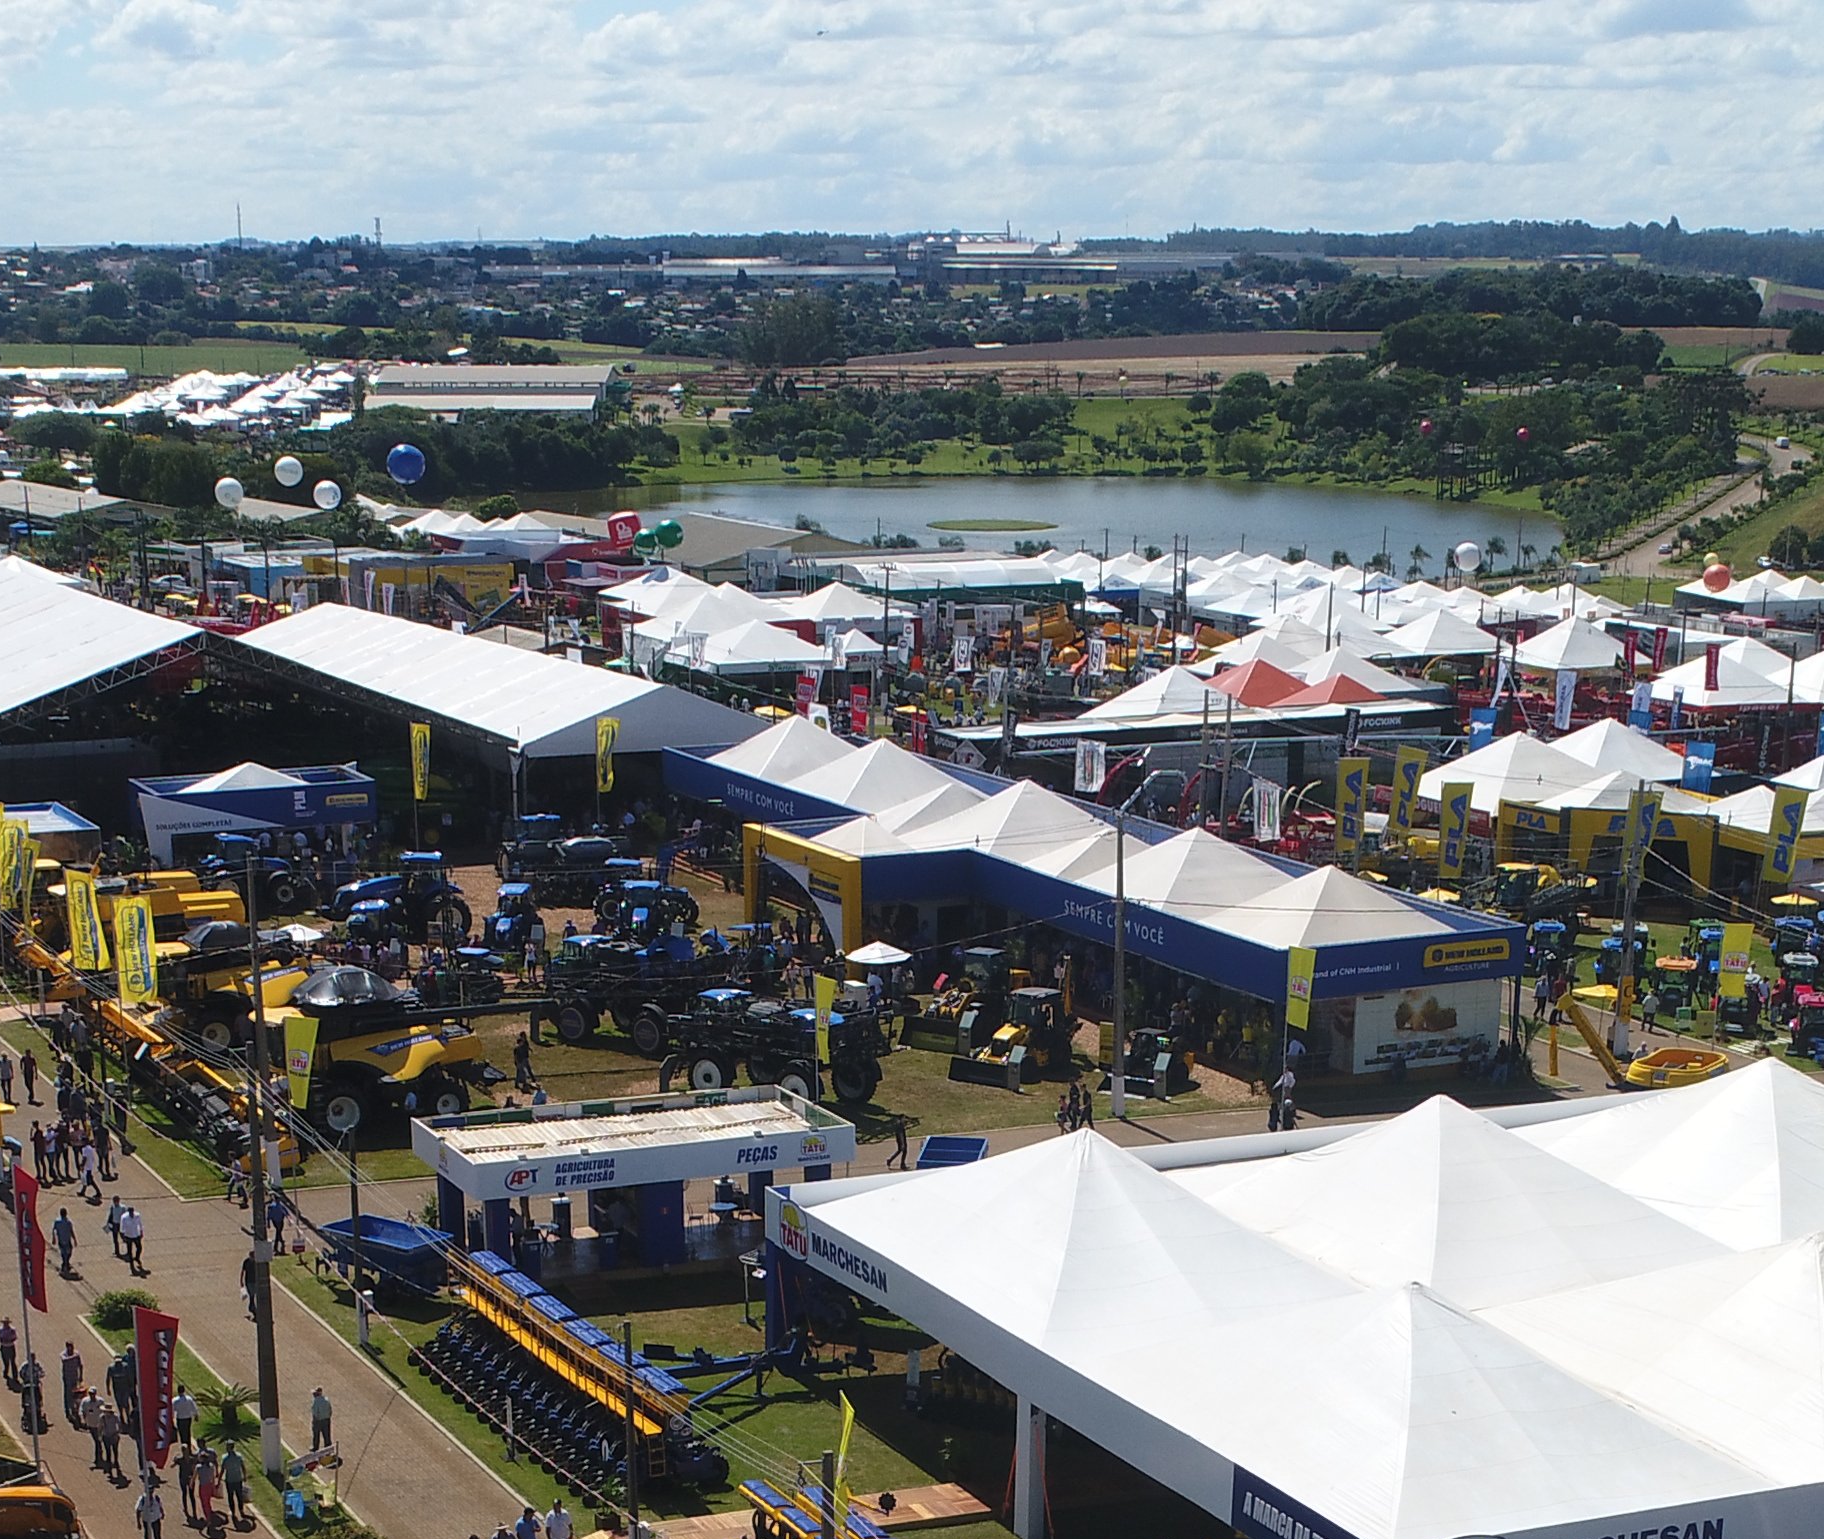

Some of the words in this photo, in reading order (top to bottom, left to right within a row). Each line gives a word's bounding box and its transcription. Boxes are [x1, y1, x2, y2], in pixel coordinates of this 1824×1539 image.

[727, 783, 754, 803] SEMPRE
[755, 793, 773, 809] COM
[773, 799, 795, 817] VOCÊ
[1342, 768, 1363, 839] PLA
[1398, 763, 1420, 827] PLA
[1446, 793, 1467, 868] PLA
[1517, 811, 1546, 829] PLA
[1773, 802, 1802, 874] PLA
[1063, 898, 1103, 926] SEMPRE
[1132, 922, 1165, 946] VOCÊ
[1314, 970, 1329, 979] rand
[1339, 966, 1356, 976] CNH
[1358, 964, 1391, 975] Industrial
[736, 1144, 778, 1166] PEÇAS
[801, 1143, 826, 1154] TATU
[509, 1168, 539, 1186] APT
[554, 1157, 616, 1175] AGRICULTURA
[555, 1174, 567, 1187] DE
[569, 1168, 615, 1186] PRECISÃO
[780, 1223, 807, 1257] TATU
[812, 1232, 889, 1295] MARCHESAN
[1242, 1491, 1252, 1516] A
